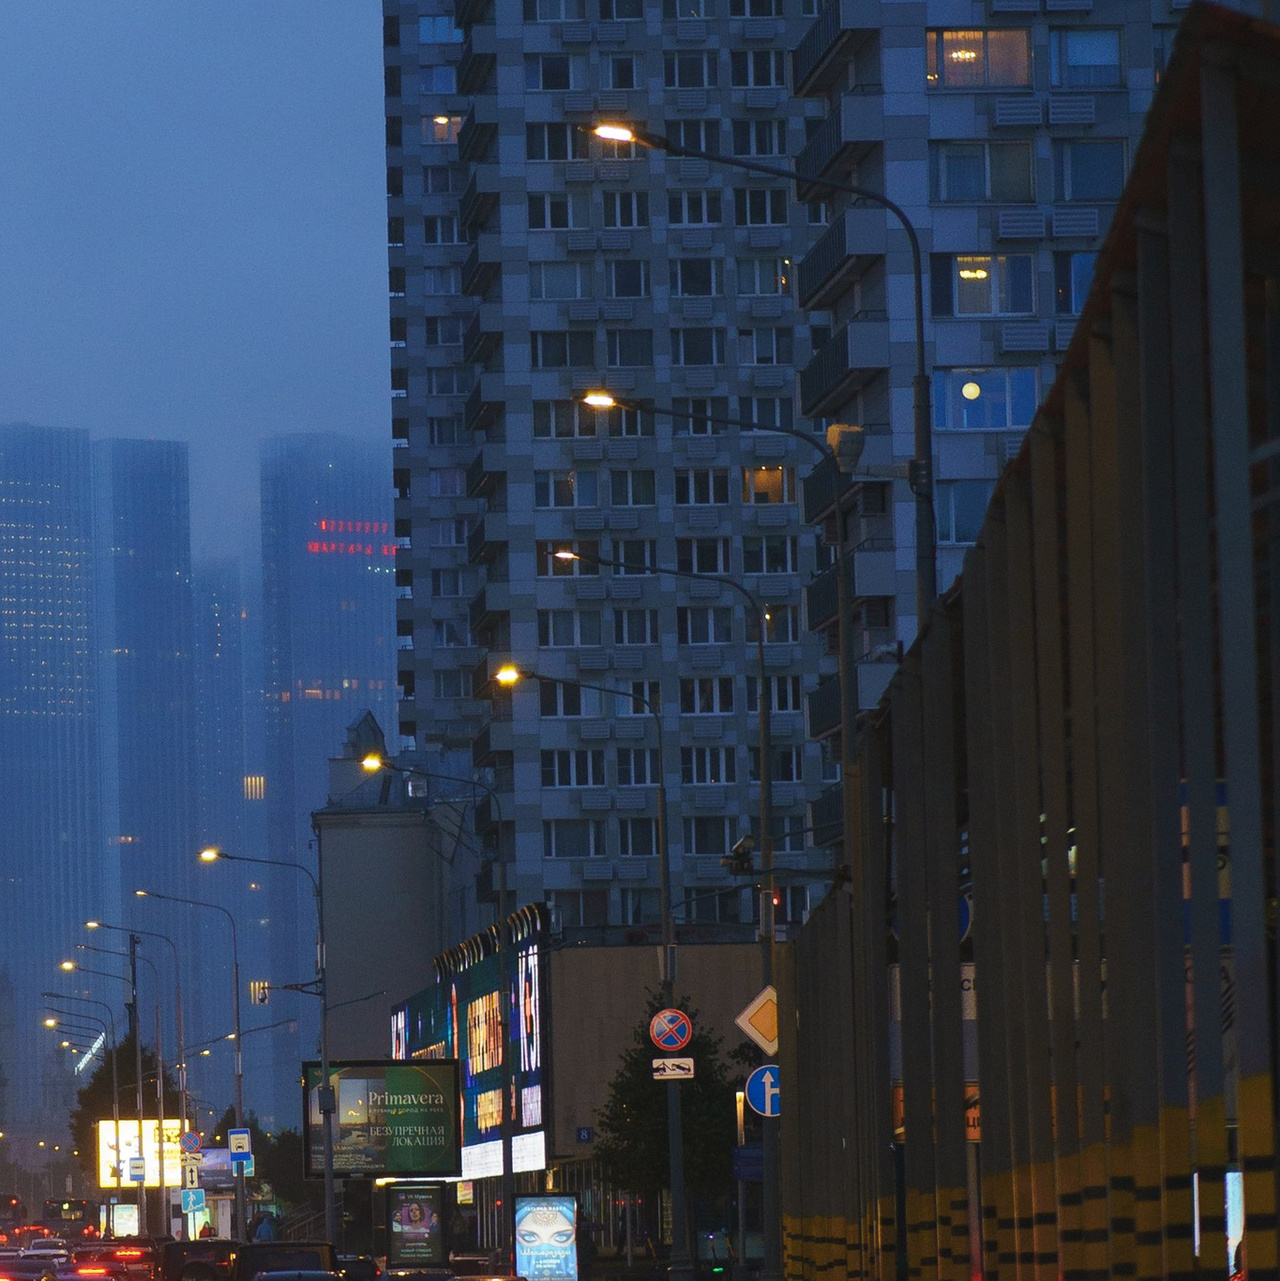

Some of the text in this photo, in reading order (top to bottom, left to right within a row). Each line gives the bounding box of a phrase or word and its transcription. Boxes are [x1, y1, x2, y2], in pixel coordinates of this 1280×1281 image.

[369, 1091, 444, 1106] Primavera
[370, 1126, 444, 1136] БЕЗУПРЕЧНАЯ
[580, 1129, 588, 1140] 8
[392, 1137, 444, 1147] ЛОКАЦИЯ
